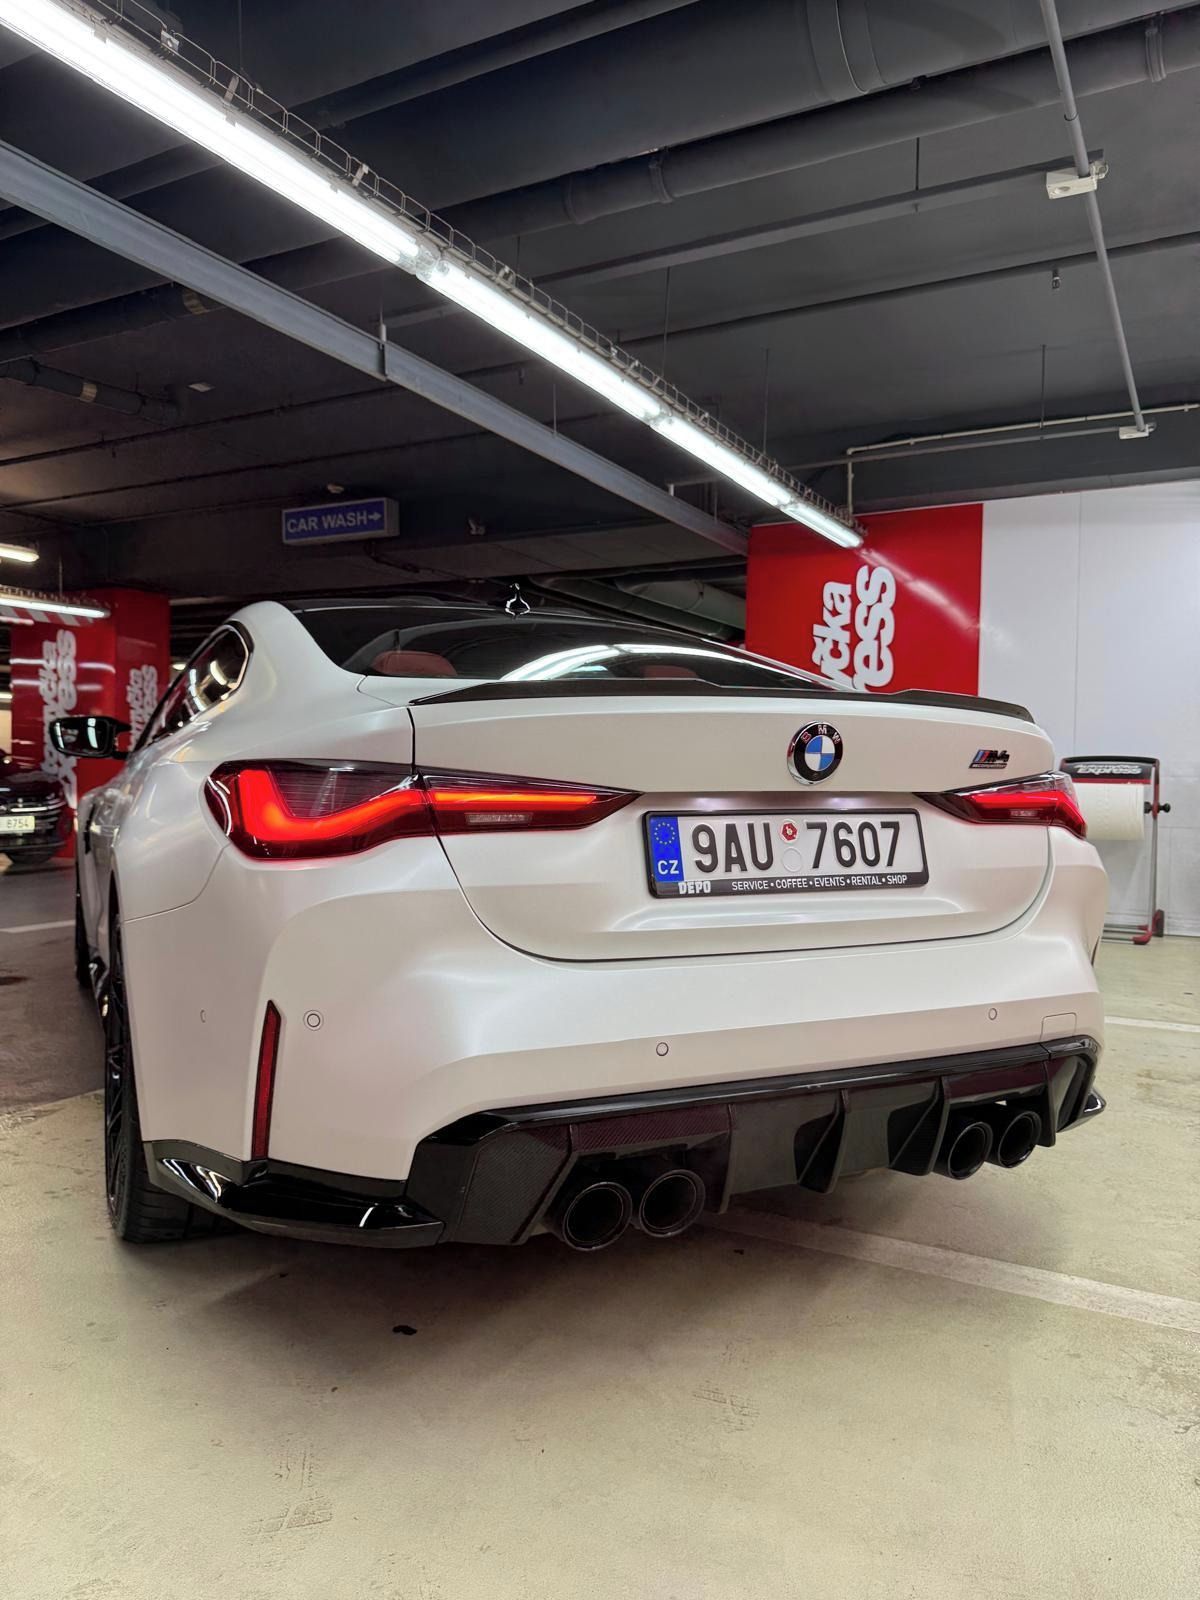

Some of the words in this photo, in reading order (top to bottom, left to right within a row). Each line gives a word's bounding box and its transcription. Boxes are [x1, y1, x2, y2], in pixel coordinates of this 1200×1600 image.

[287, 516, 318, 533] CAR
[321, 510, 367, 529] WASH
[801, 724, 841, 745] BMW
[691, 822, 774, 873] 9AU
[806, 821, 900, 869] 7607
[657, 859, 680, 875] CZ
[678, 880, 711, 895] DEPO
[732, 880, 769, 891] SERVICE
[775, 878, 808, 889] COFFEE
[814, 877, 846, 888] EVENTS
[852, 875, 882, 886] RENTAL
[887, 874, 908, 885] SHOP
